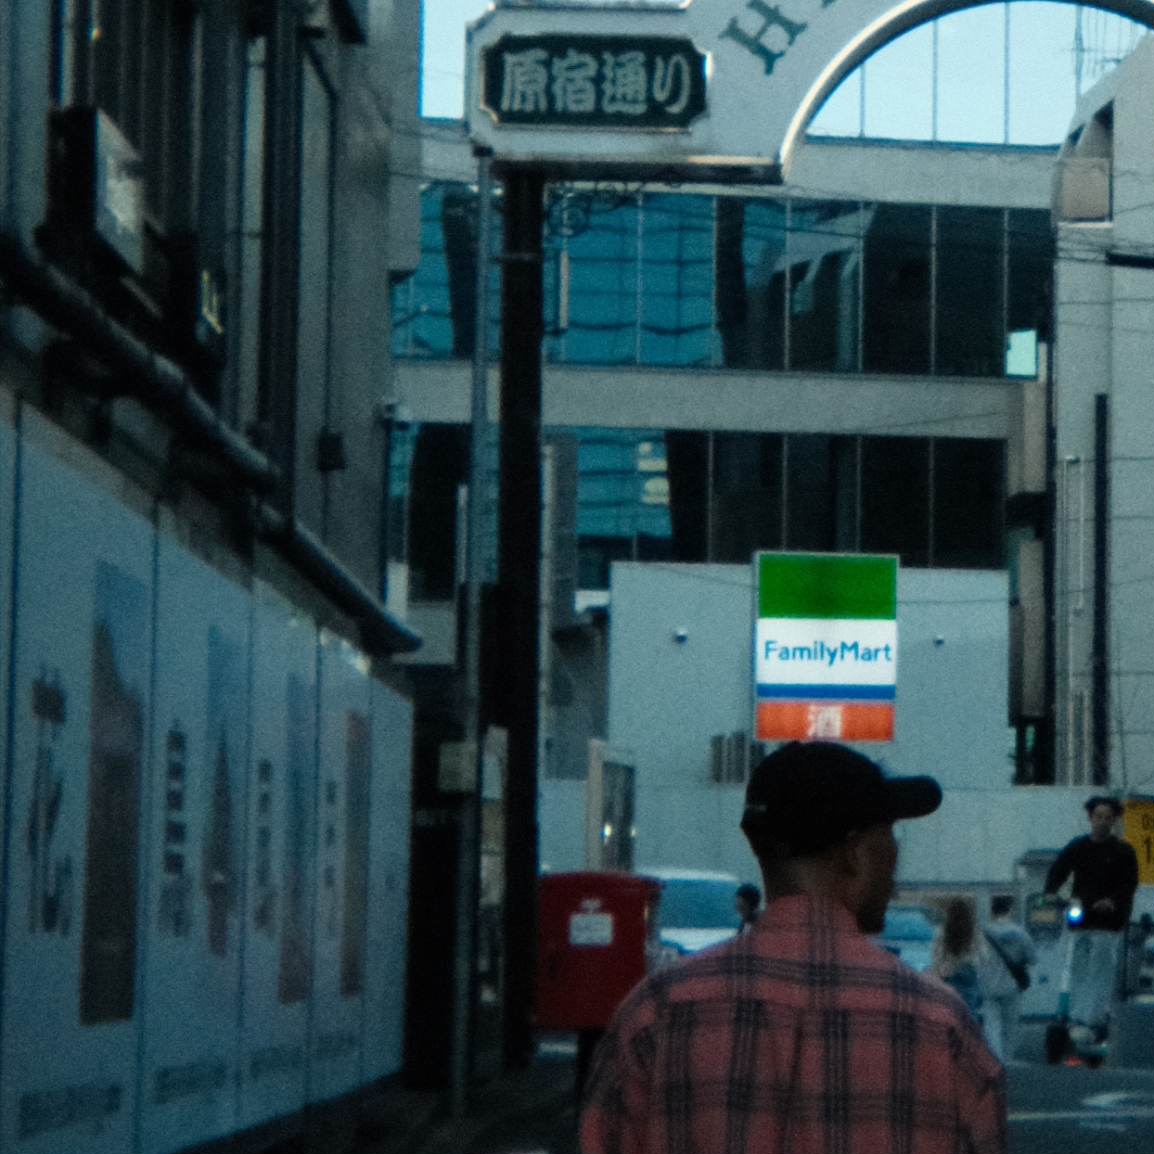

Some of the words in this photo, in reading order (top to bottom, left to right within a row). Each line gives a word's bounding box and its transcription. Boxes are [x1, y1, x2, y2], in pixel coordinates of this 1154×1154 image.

[501, 49, 691, 115] 原宿通り
[764, 640, 892, 667] FamilyMart
